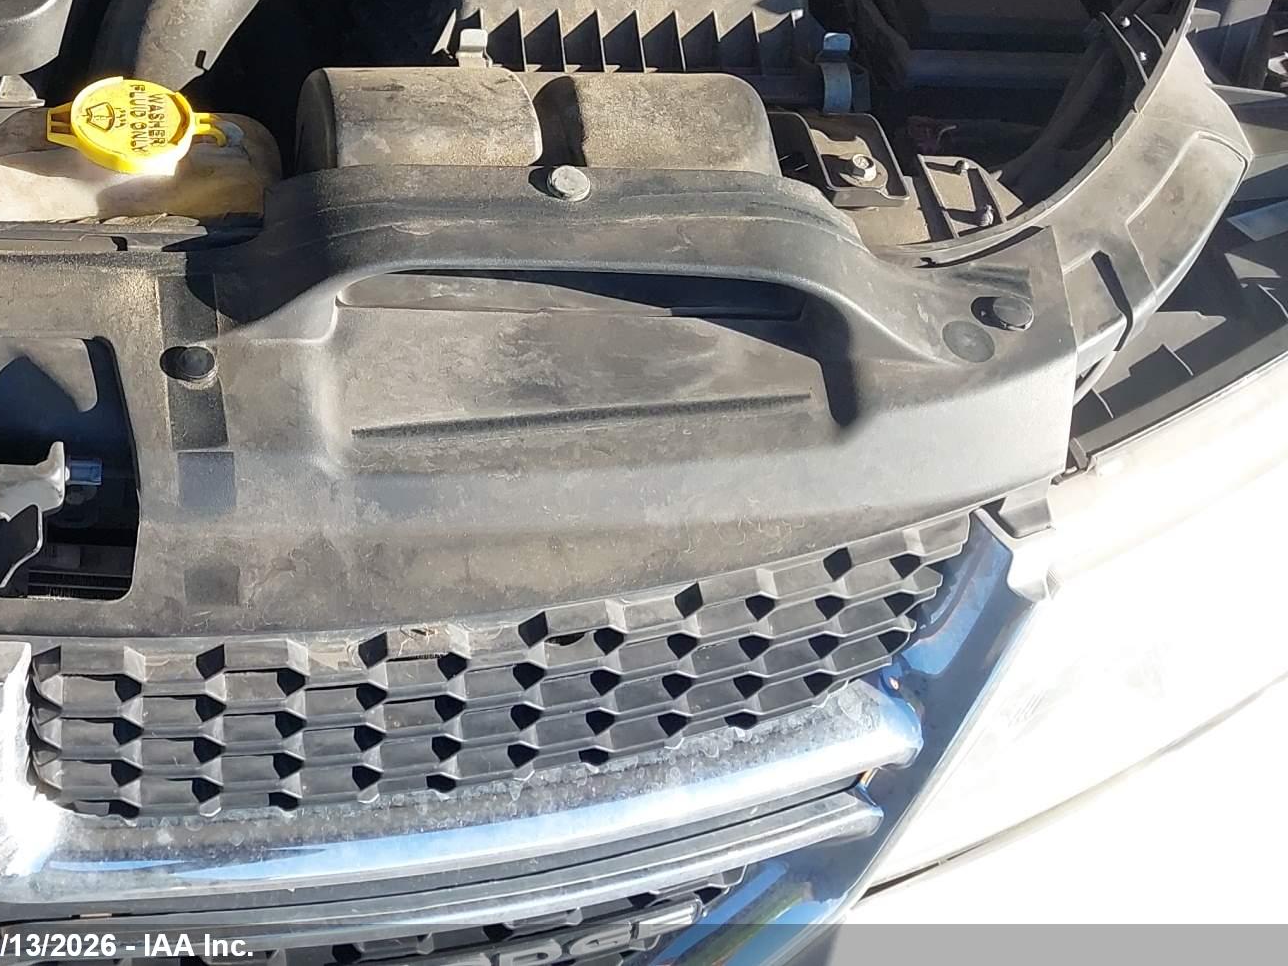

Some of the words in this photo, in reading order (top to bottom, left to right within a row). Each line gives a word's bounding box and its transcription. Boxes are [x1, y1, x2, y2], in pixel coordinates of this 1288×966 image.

[129, 84, 147, 117] FLUID
[148, 92, 166, 148] WASHER
[130, 121, 149, 153] ONLY
